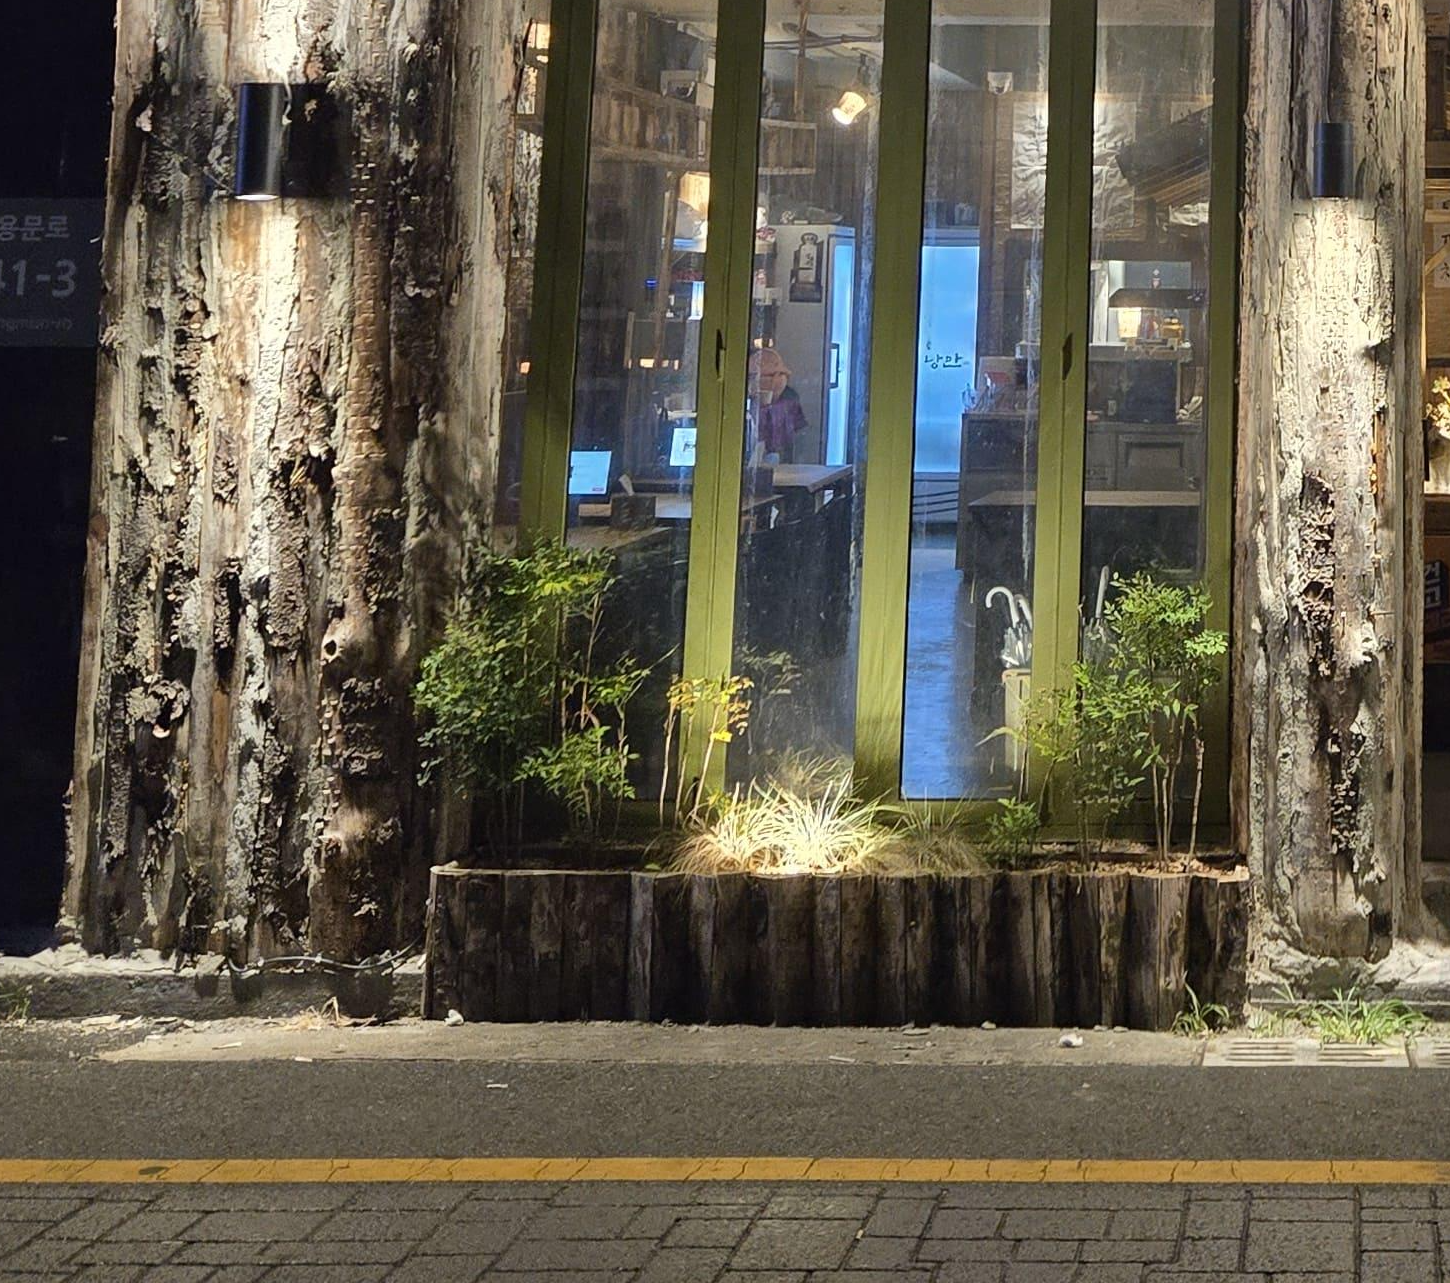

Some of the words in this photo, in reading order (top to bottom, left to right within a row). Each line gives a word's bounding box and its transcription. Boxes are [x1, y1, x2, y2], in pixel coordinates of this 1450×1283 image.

[0, 214, 71, 242] 용문로
[0, 258, 78, 299] 1-3
[924, 352, 964, 370] 낭만
